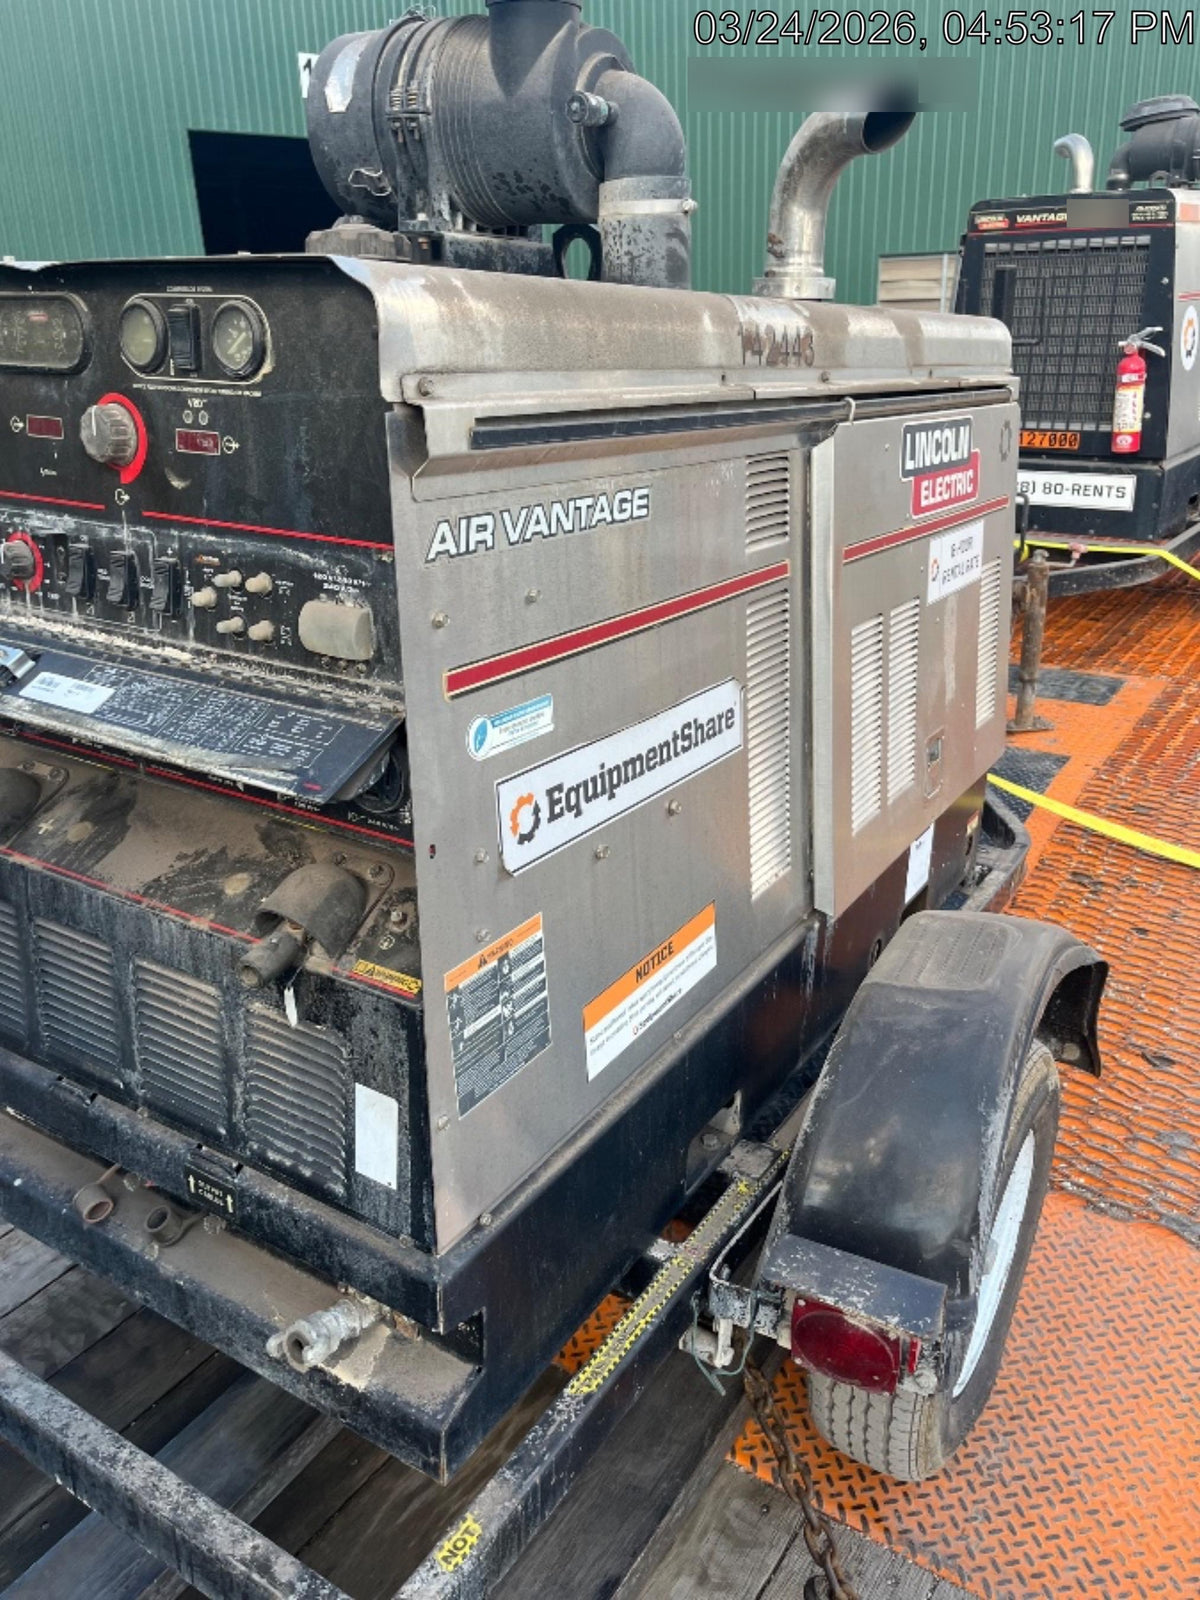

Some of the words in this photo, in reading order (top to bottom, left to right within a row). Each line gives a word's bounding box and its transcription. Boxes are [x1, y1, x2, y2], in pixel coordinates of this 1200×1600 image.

[905, 425, 971, 471] LINCOLN
[920, 468, 973, 507] ELECTRIC
[424, 512, 495, 563] AIR
[501, 486, 651, 546] VANTAGE
[545, 704, 736, 827] EquipmentShare
[635, 940, 676, 984] NOTICE
[440, 1524, 476, 1566] NOT
